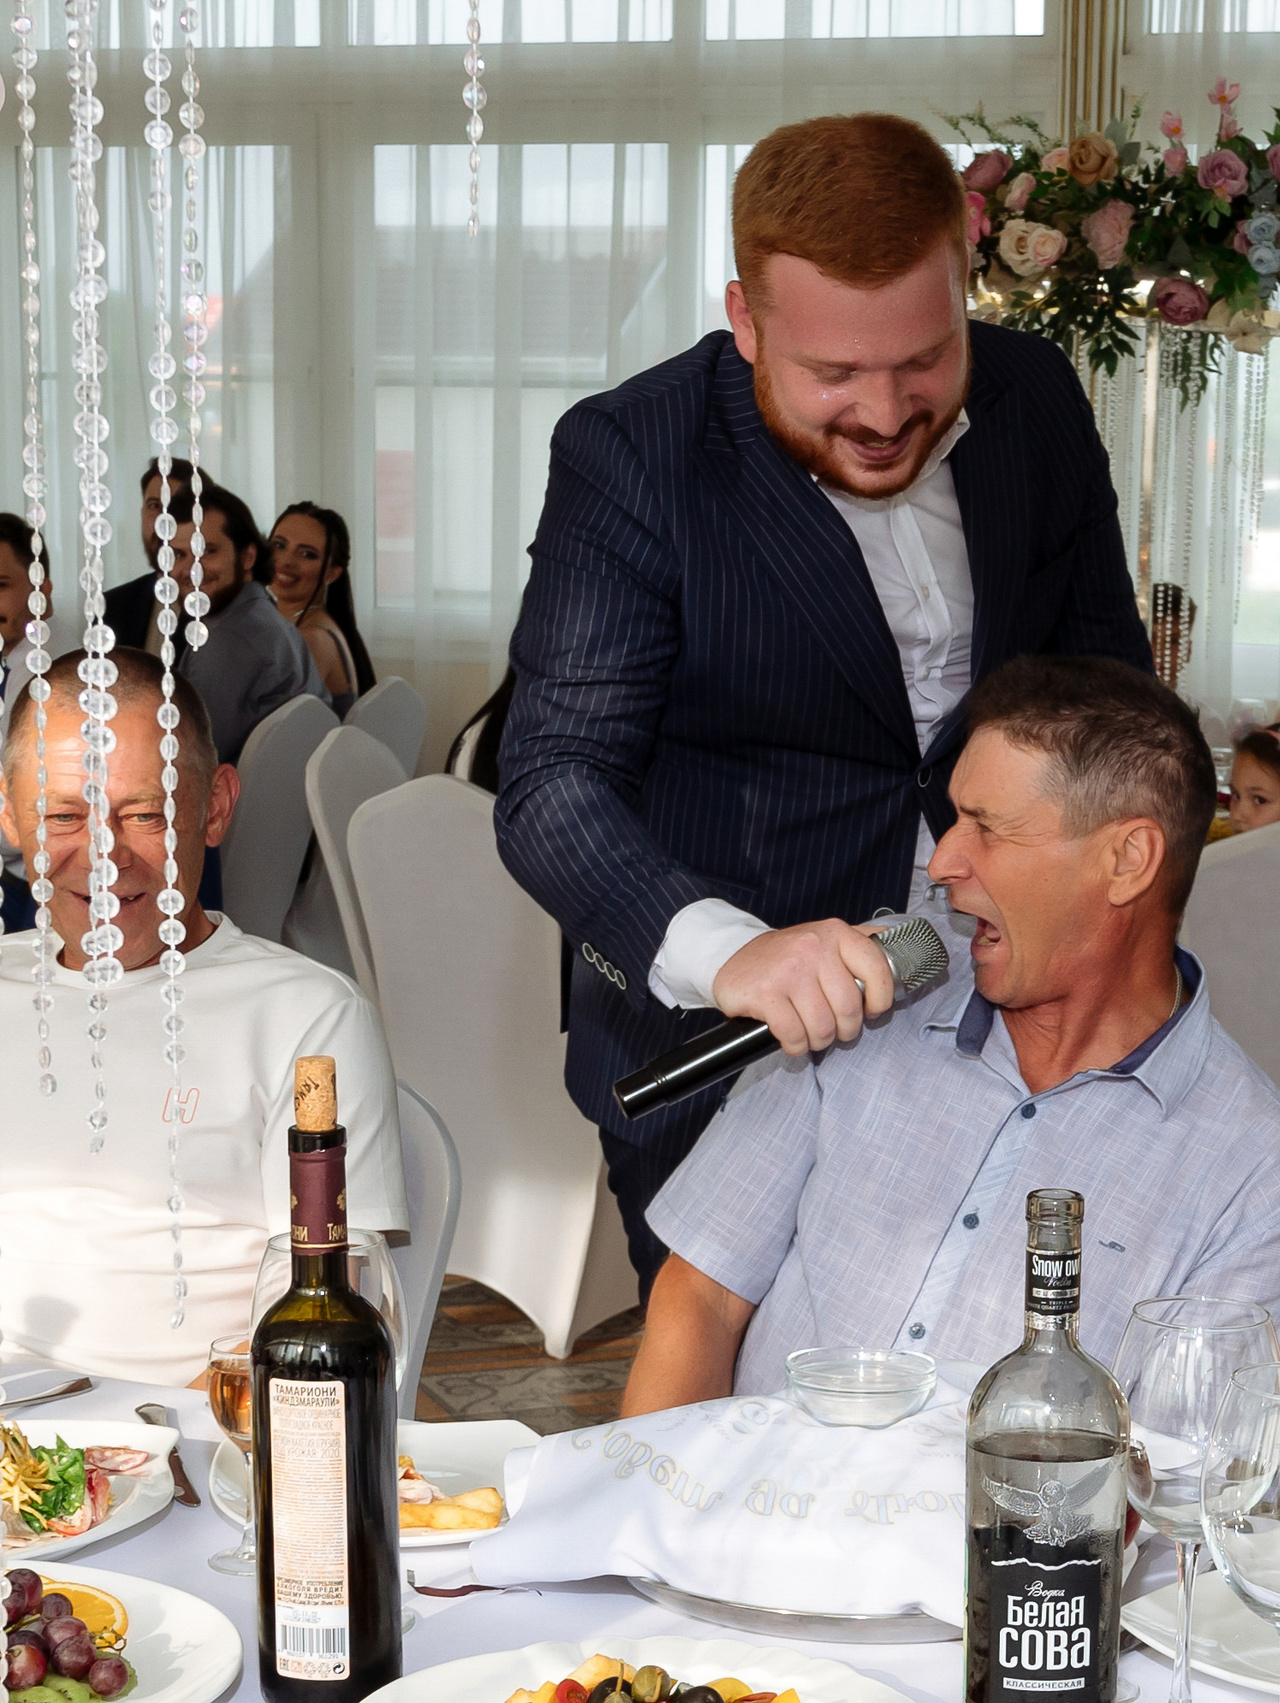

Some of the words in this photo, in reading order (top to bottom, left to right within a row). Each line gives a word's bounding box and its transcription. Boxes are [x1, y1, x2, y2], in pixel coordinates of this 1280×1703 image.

[1032, 1254, 1063, 1277] Snow
[275, 1384, 337, 1397] ТАМАРИОНИ
[276, 1582, 311, 1592] АЛКОГОЛЯ
[1025, 1580, 1065, 1602] Водка
[1005, 1679, 1083, 1690] КЛАССИЧЕСКАЯ
